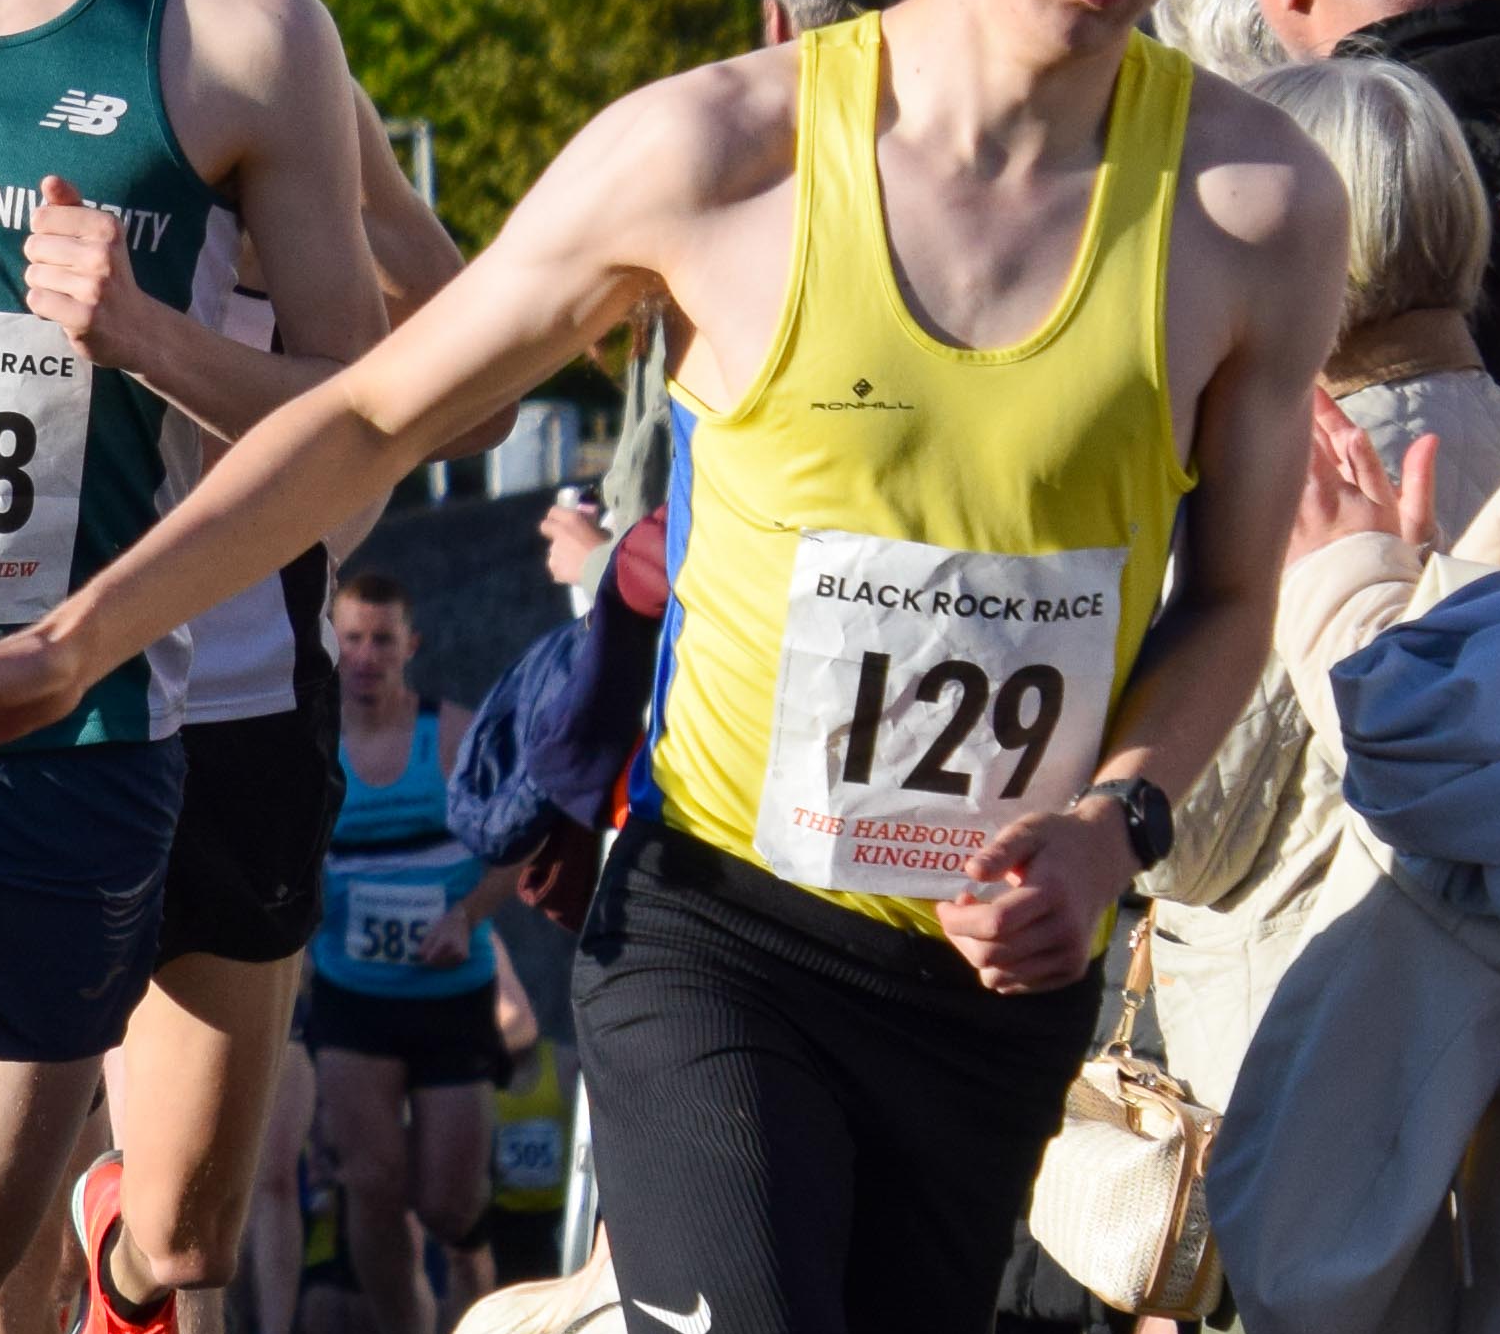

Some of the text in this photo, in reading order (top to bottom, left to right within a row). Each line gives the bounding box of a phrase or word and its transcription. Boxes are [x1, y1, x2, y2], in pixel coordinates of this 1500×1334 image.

[0, 352, 75, 378] RACE
[809, 401, 916, 411] RONHILL
[816, 573, 1104, 623] BLACK ROCK RACE
[842, 650, 1065, 800] 129
[792, 807, 987, 850] THE HARBOUR
[852, 843, 975, 874] KINGHO
